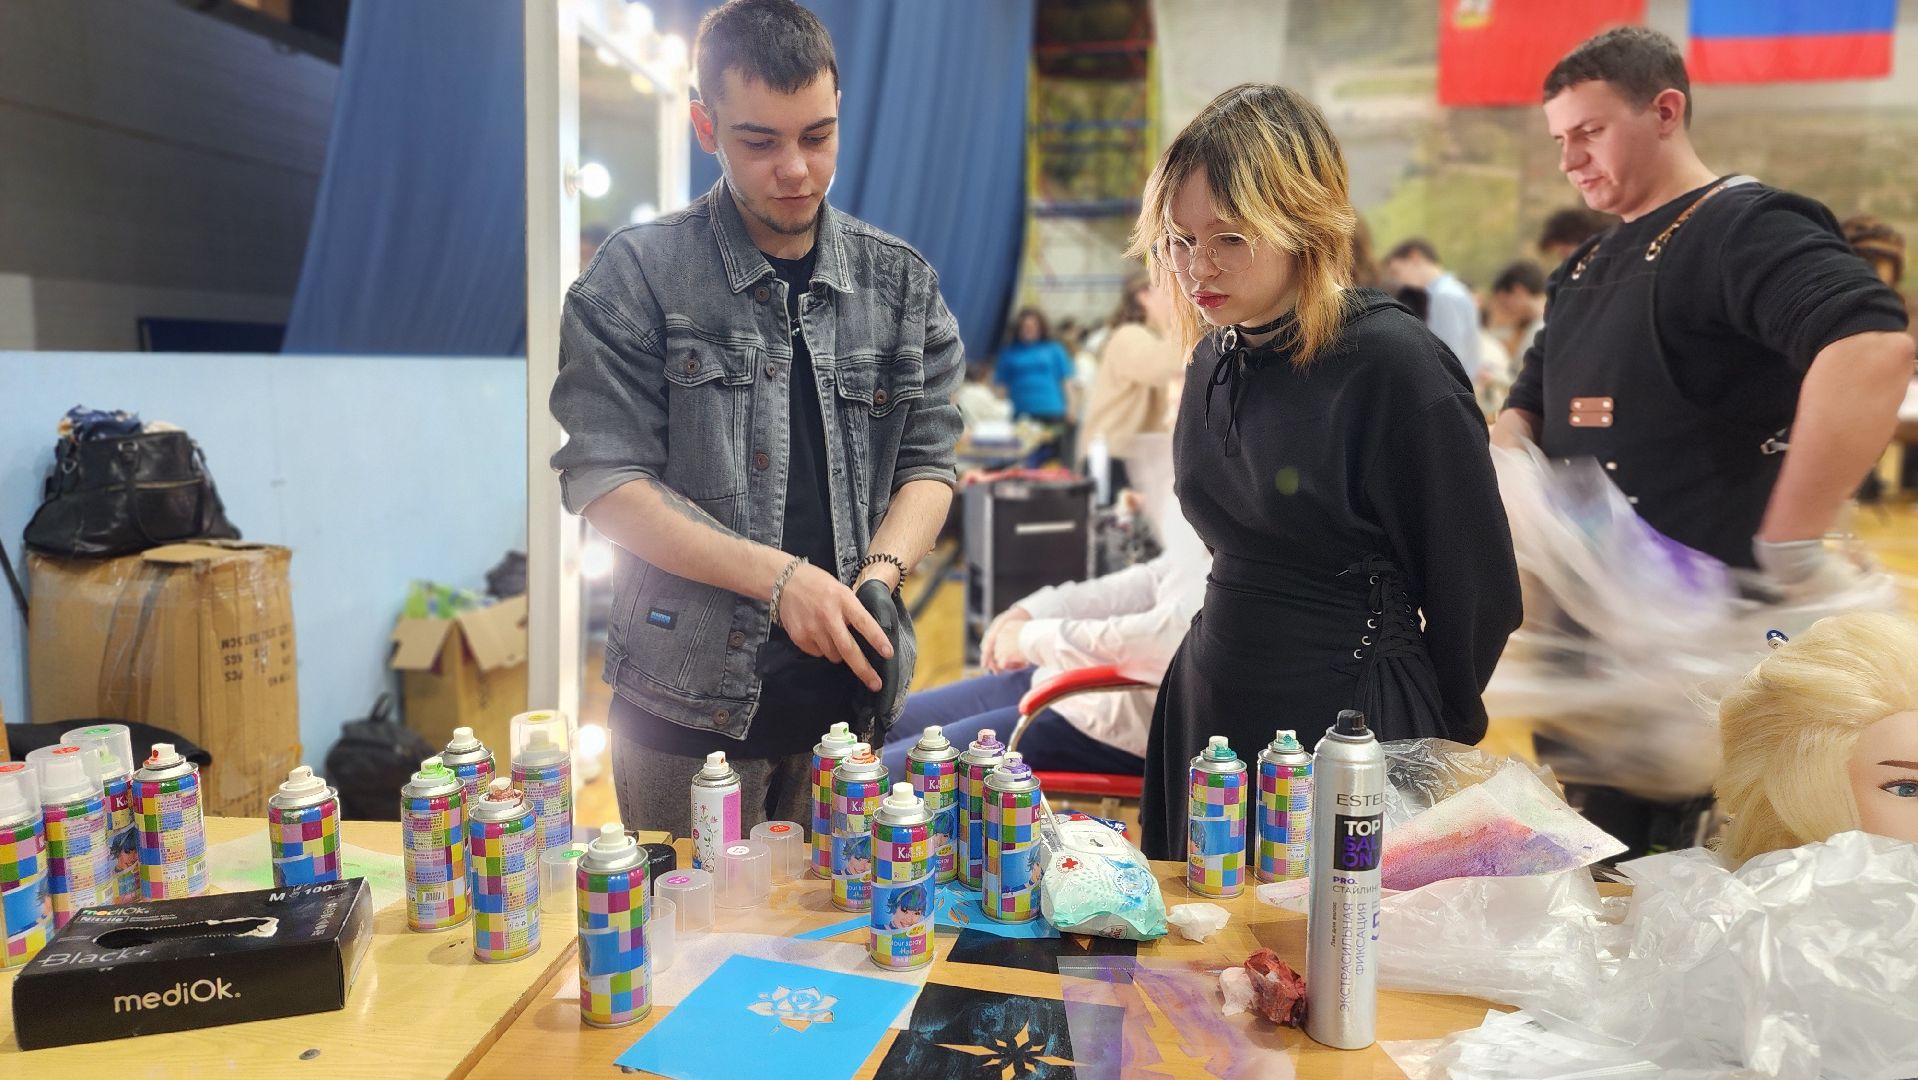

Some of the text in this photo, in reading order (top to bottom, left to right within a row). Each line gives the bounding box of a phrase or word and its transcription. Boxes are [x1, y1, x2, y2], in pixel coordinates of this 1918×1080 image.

[1336, 792, 1384, 807] ESTEL
[1344, 819, 1381, 837] TOP
[1343, 850, 1373, 868] ON
[1332, 875, 1358, 886] PRO.
[1332, 884, 1380, 895] СТАЙЛИН
[268, 892, 286, 902] M
[304, 884, 333, 895] 100
[1356, 902, 1368, 976] ФИКСАЦИЯ
[1340, 902, 1353, 1012] ЭКСТРАСИЛЬНАЯ
[113, 977, 241, 1013] mediOk.
